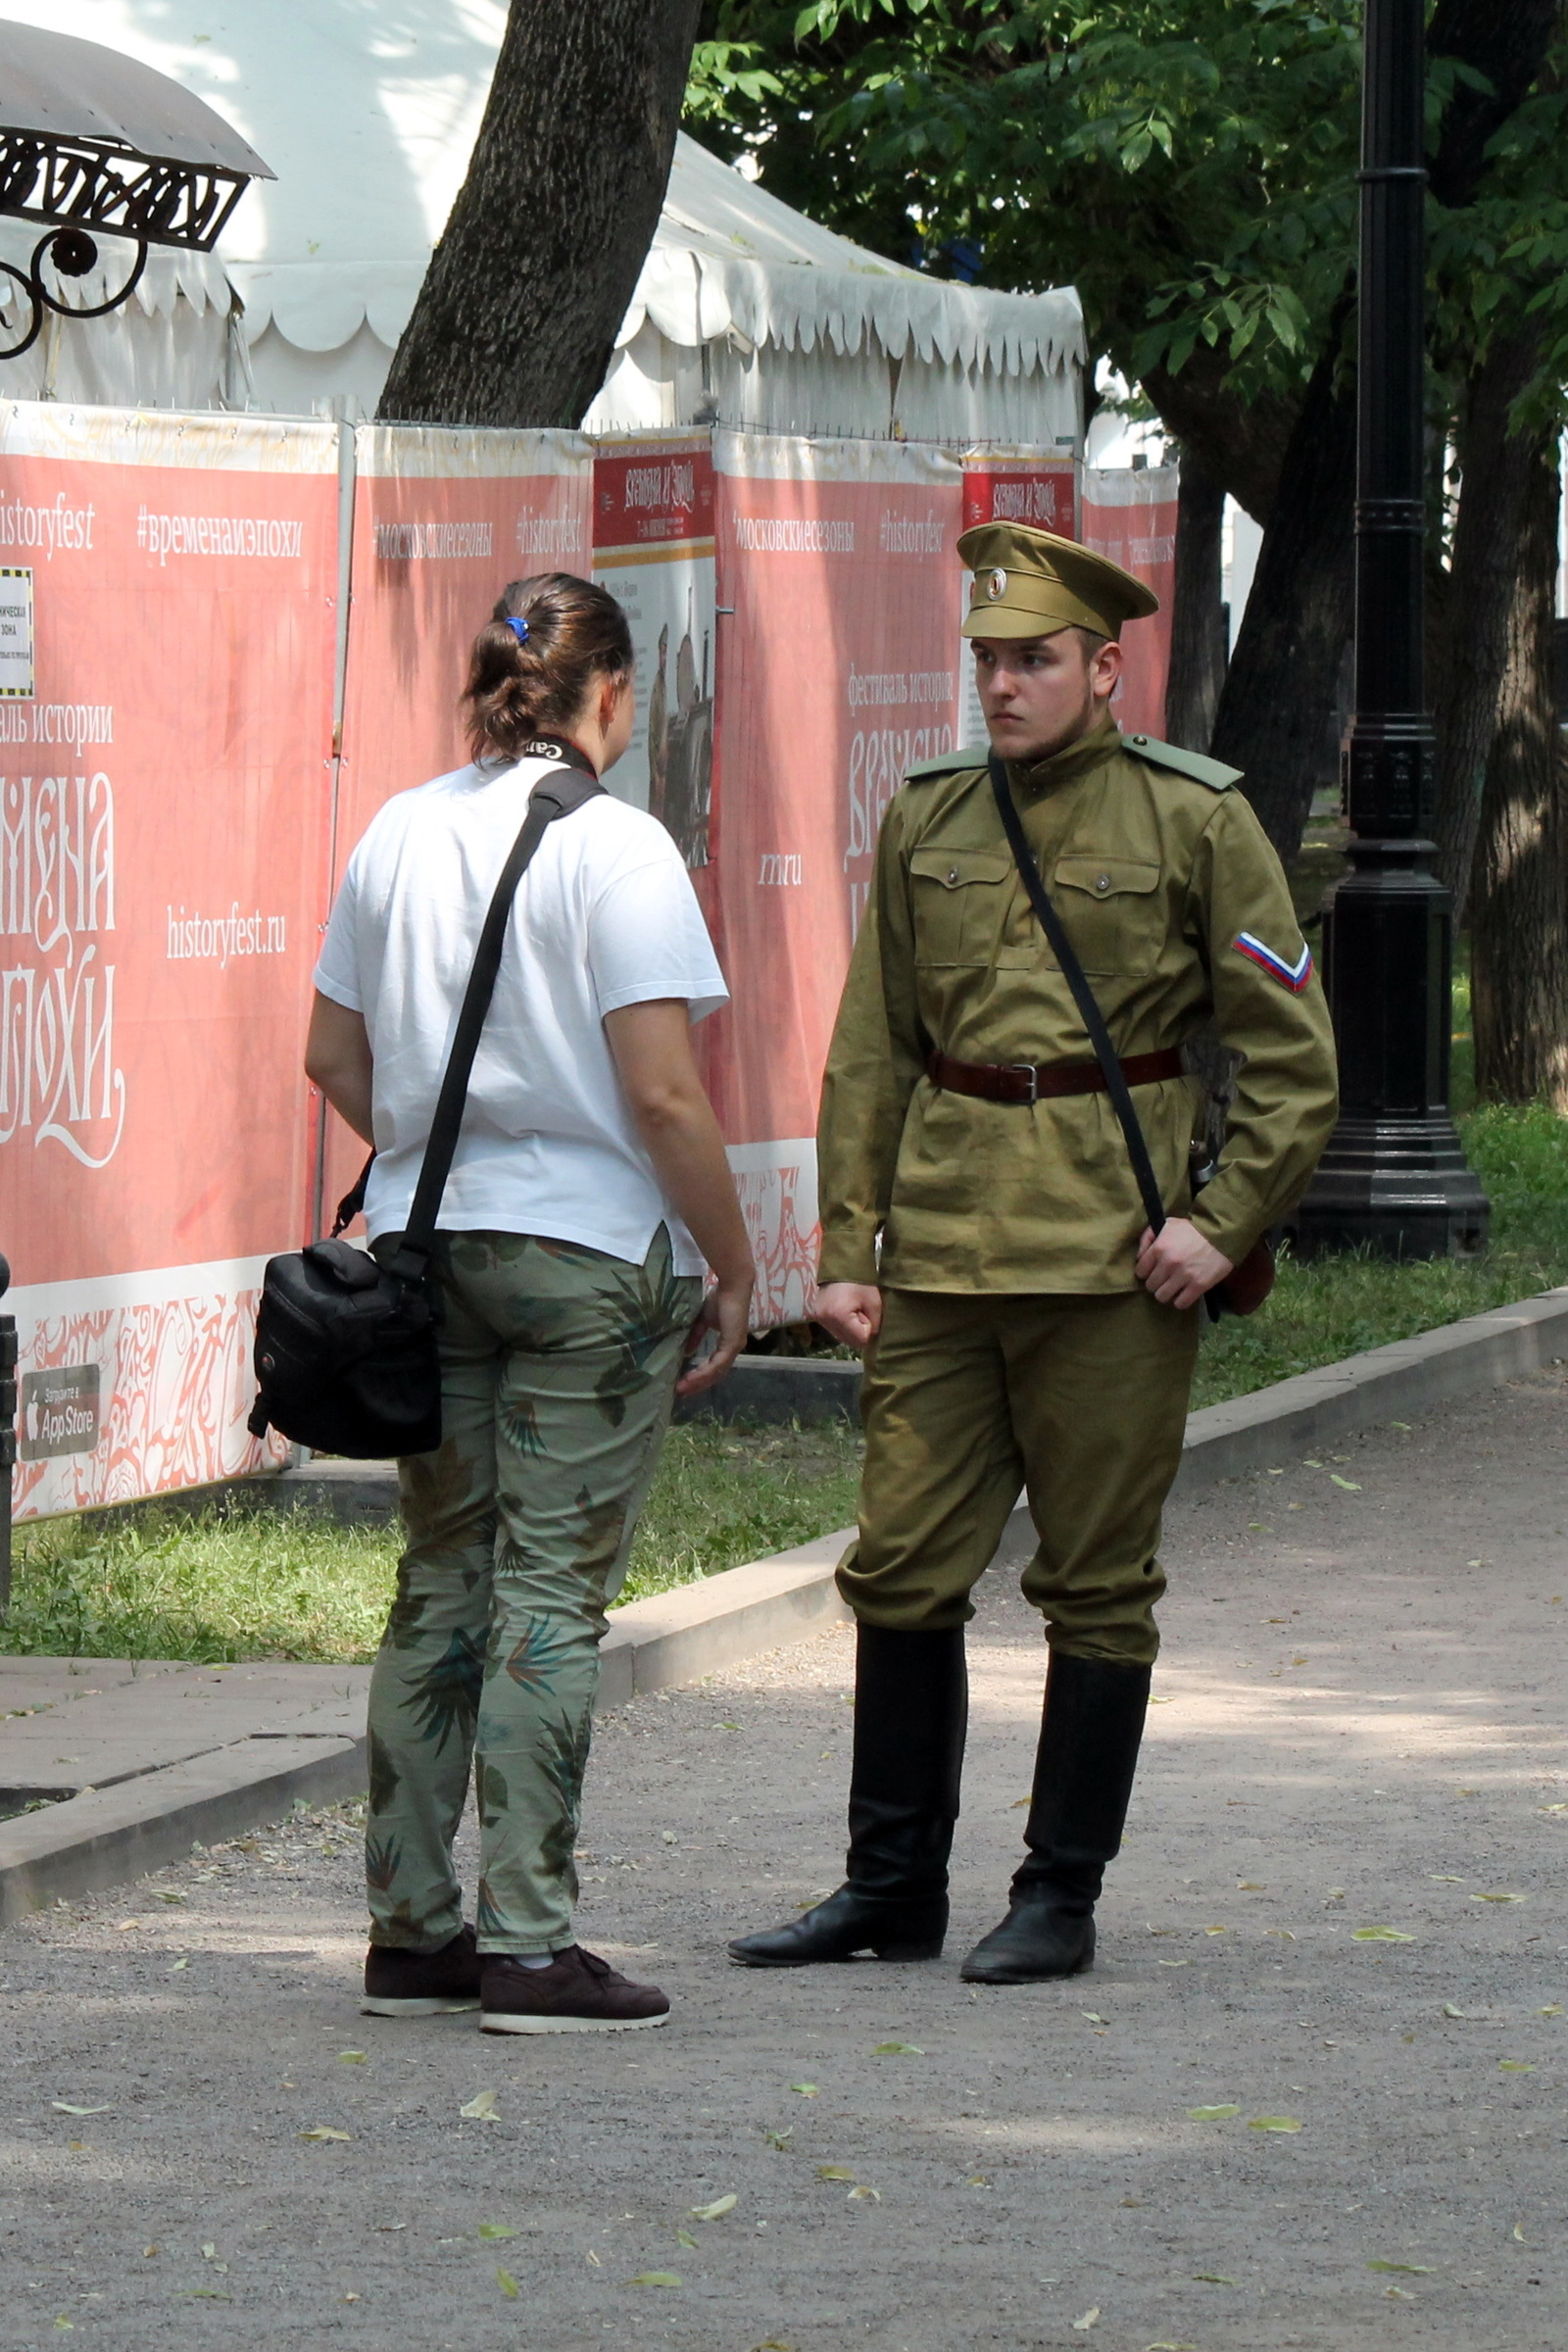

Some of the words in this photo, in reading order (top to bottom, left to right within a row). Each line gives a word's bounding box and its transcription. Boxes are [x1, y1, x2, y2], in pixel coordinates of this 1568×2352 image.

[136, 504, 303, 566] #временаиэпохи
[32, 704, 114, 757] истории
[166, 902, 286, 968] historyfest.ru
[65, 1404, 94, 1436] Store
